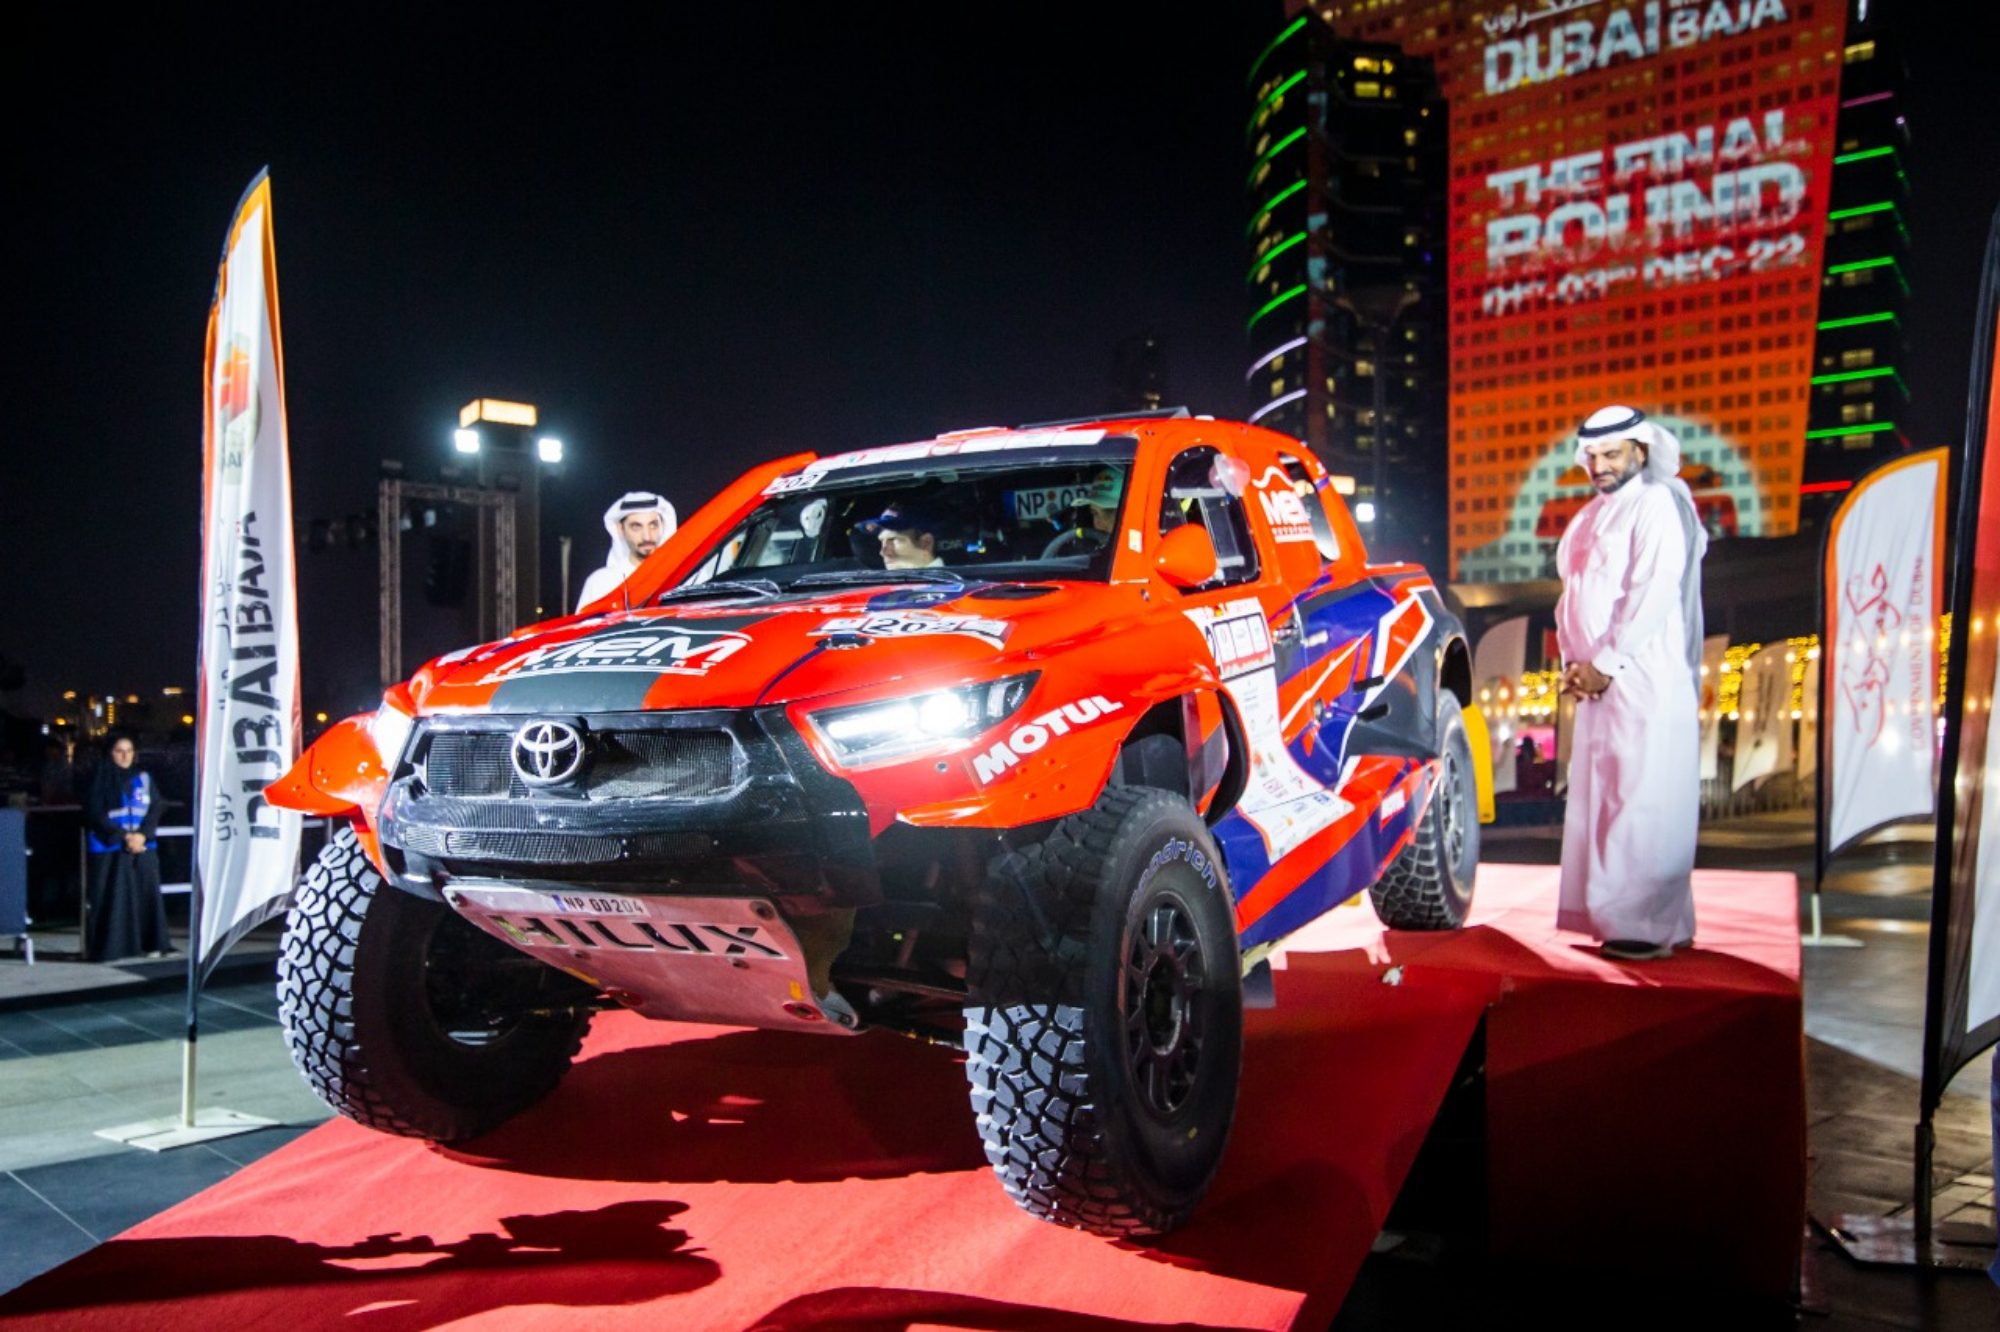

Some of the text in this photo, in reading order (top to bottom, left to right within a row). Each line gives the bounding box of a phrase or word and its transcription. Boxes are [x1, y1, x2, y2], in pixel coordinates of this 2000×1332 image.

[1484, 0, 1788, 95] DUBAI BAJA
[1487, 150, 1604, 208] THE
[1016, 492, 1045, 516] NP
[230, 644, 282, 840] DUBAI
[972, 695, 1124, 785] MOTUL
[563, 896, 585, 910] NP
[487, 914, 790, 959] HILUX
